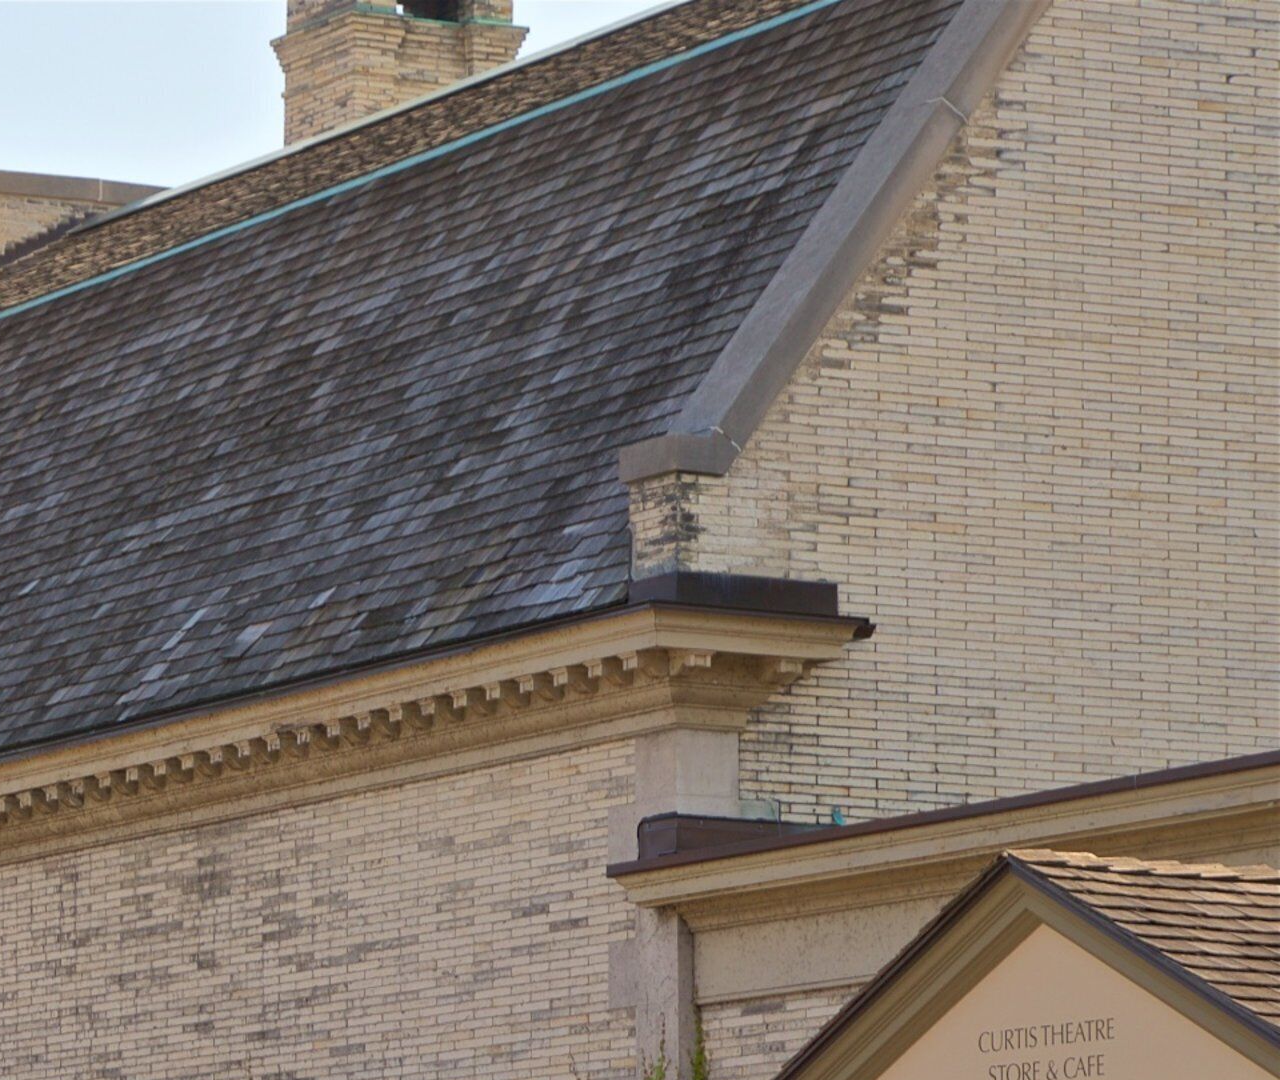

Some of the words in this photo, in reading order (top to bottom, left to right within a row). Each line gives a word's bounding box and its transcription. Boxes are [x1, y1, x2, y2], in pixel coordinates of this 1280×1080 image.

[978, 1026, 1038, 1053] CURTIS
[1041, 1017, 1115, 1047] THEATRE
[1046, 1060, 1058, 1080] &
[1063, 1054, 1105, 1080] CAFE
